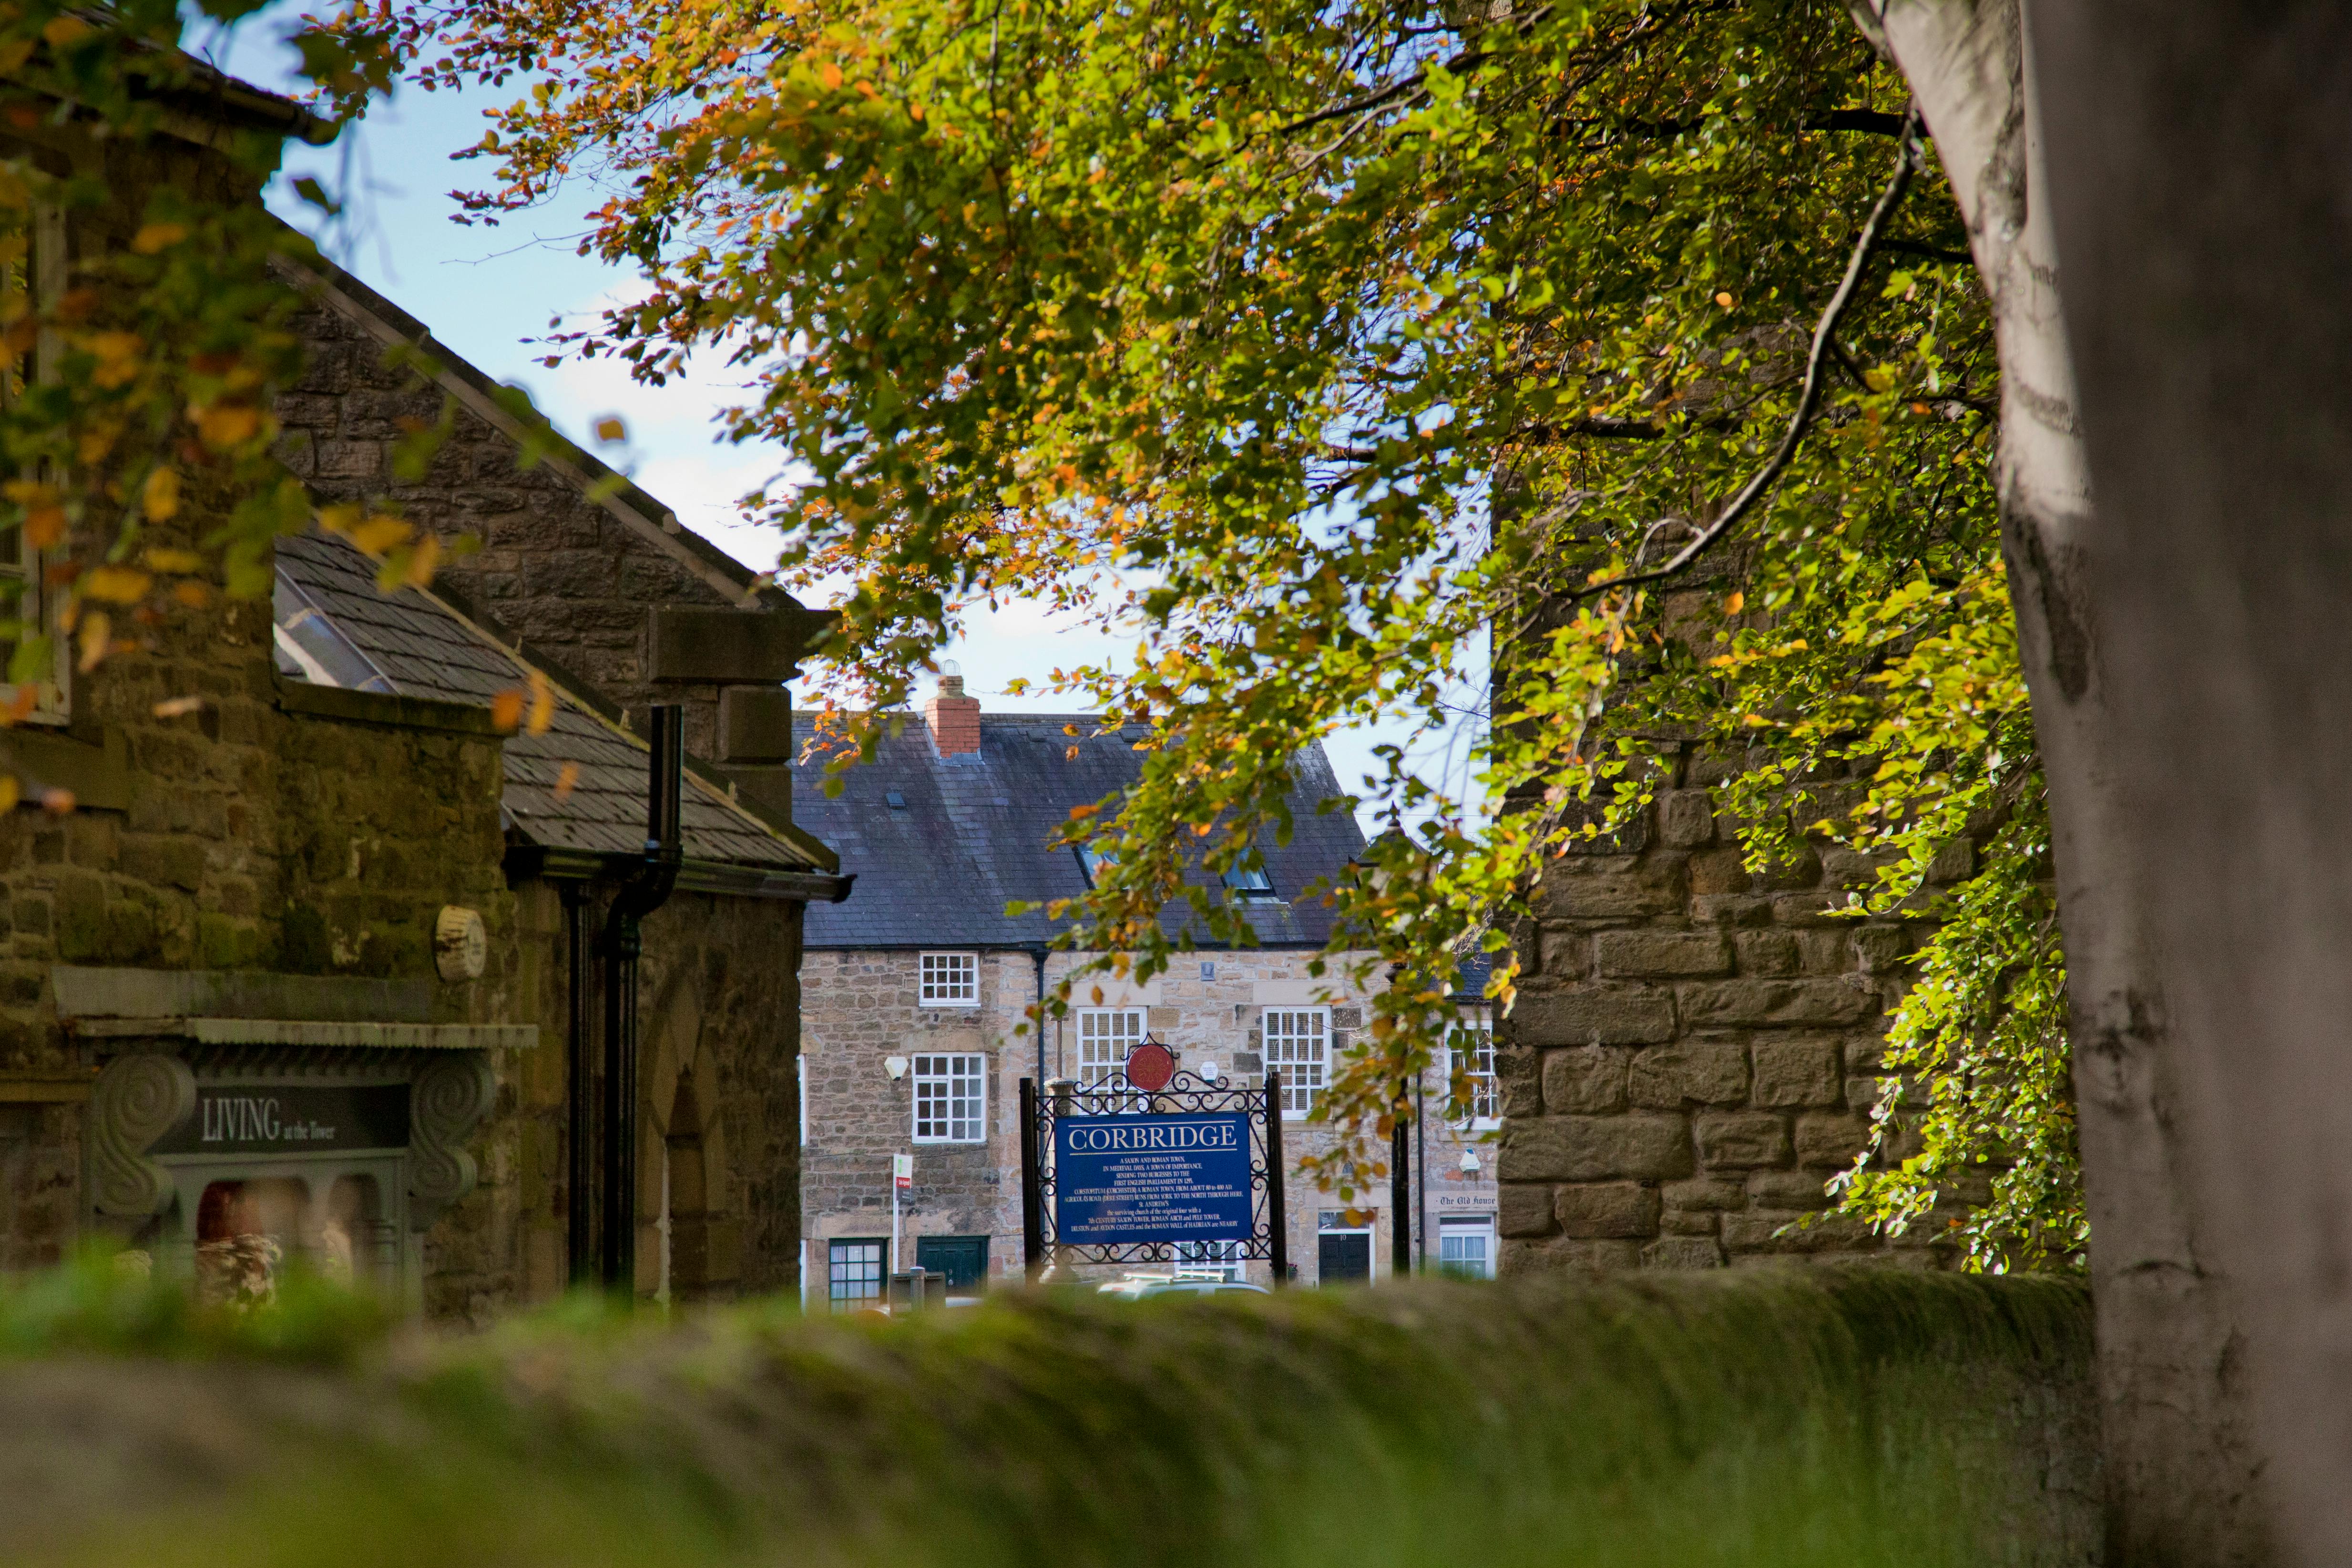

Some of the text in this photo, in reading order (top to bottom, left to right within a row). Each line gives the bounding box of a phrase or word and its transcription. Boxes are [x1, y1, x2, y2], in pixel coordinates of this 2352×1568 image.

[203, 1098, 280, 1141] LIVING
[1069, 1125, 1237, 1150] CORBRIDGE
[1441, 1197, 1454, 1205] The
[1457, 1197, 1470, 1205] Old
